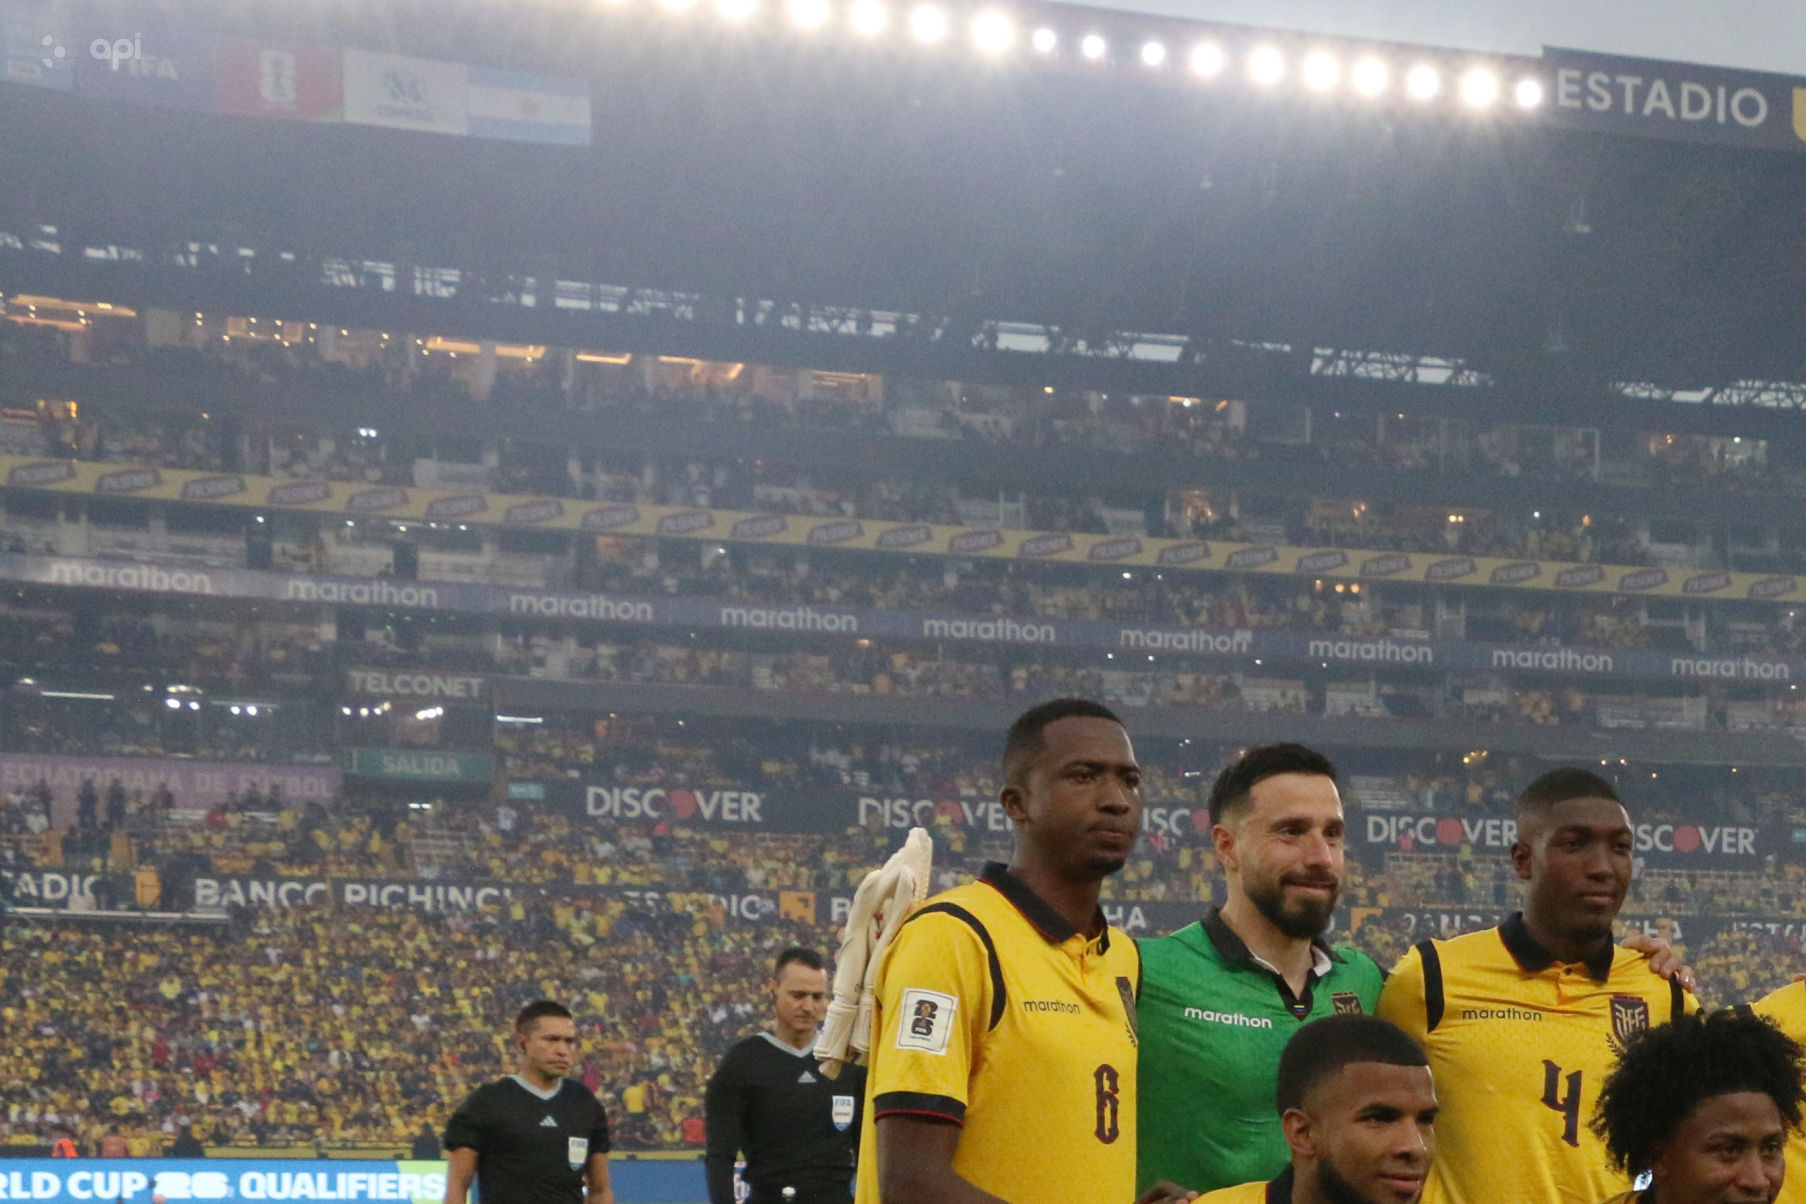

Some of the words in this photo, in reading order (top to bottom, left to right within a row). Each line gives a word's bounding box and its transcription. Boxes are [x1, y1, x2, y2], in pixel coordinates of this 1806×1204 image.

[1556, 68, 1769, 128] ESTADIO
[50, 562, 212, 594] marathon
[287, 578, 437, 607] marathon
[510, 594, 653, 621] marathon
[721, 607, 858, 632] marathon
[923, 618, 1056, 642] marathon
[1120, 629, 1247, 654] marathon
[1309, 639, 1432, 663] marathon
[1492, 649, 1613, 672] marathon
[350, 671, 483, 698] TELCONET
[383, 756, 460, 775] SALIDA
[195, 772, 227, 793] DE
[586, 786, 763, 822] DISCOVER
[1024, 1000, 1081, 1015] marathon
[1184, 1007, 1272, 1030] marathon
[1462, 1008, 1542, 1022] marathon
[1541, 1060, 1583, 1147] 4
[67, 1171, 148, 1199] CUP
[239, 1172, 446, 1200] QUALIFIERS
